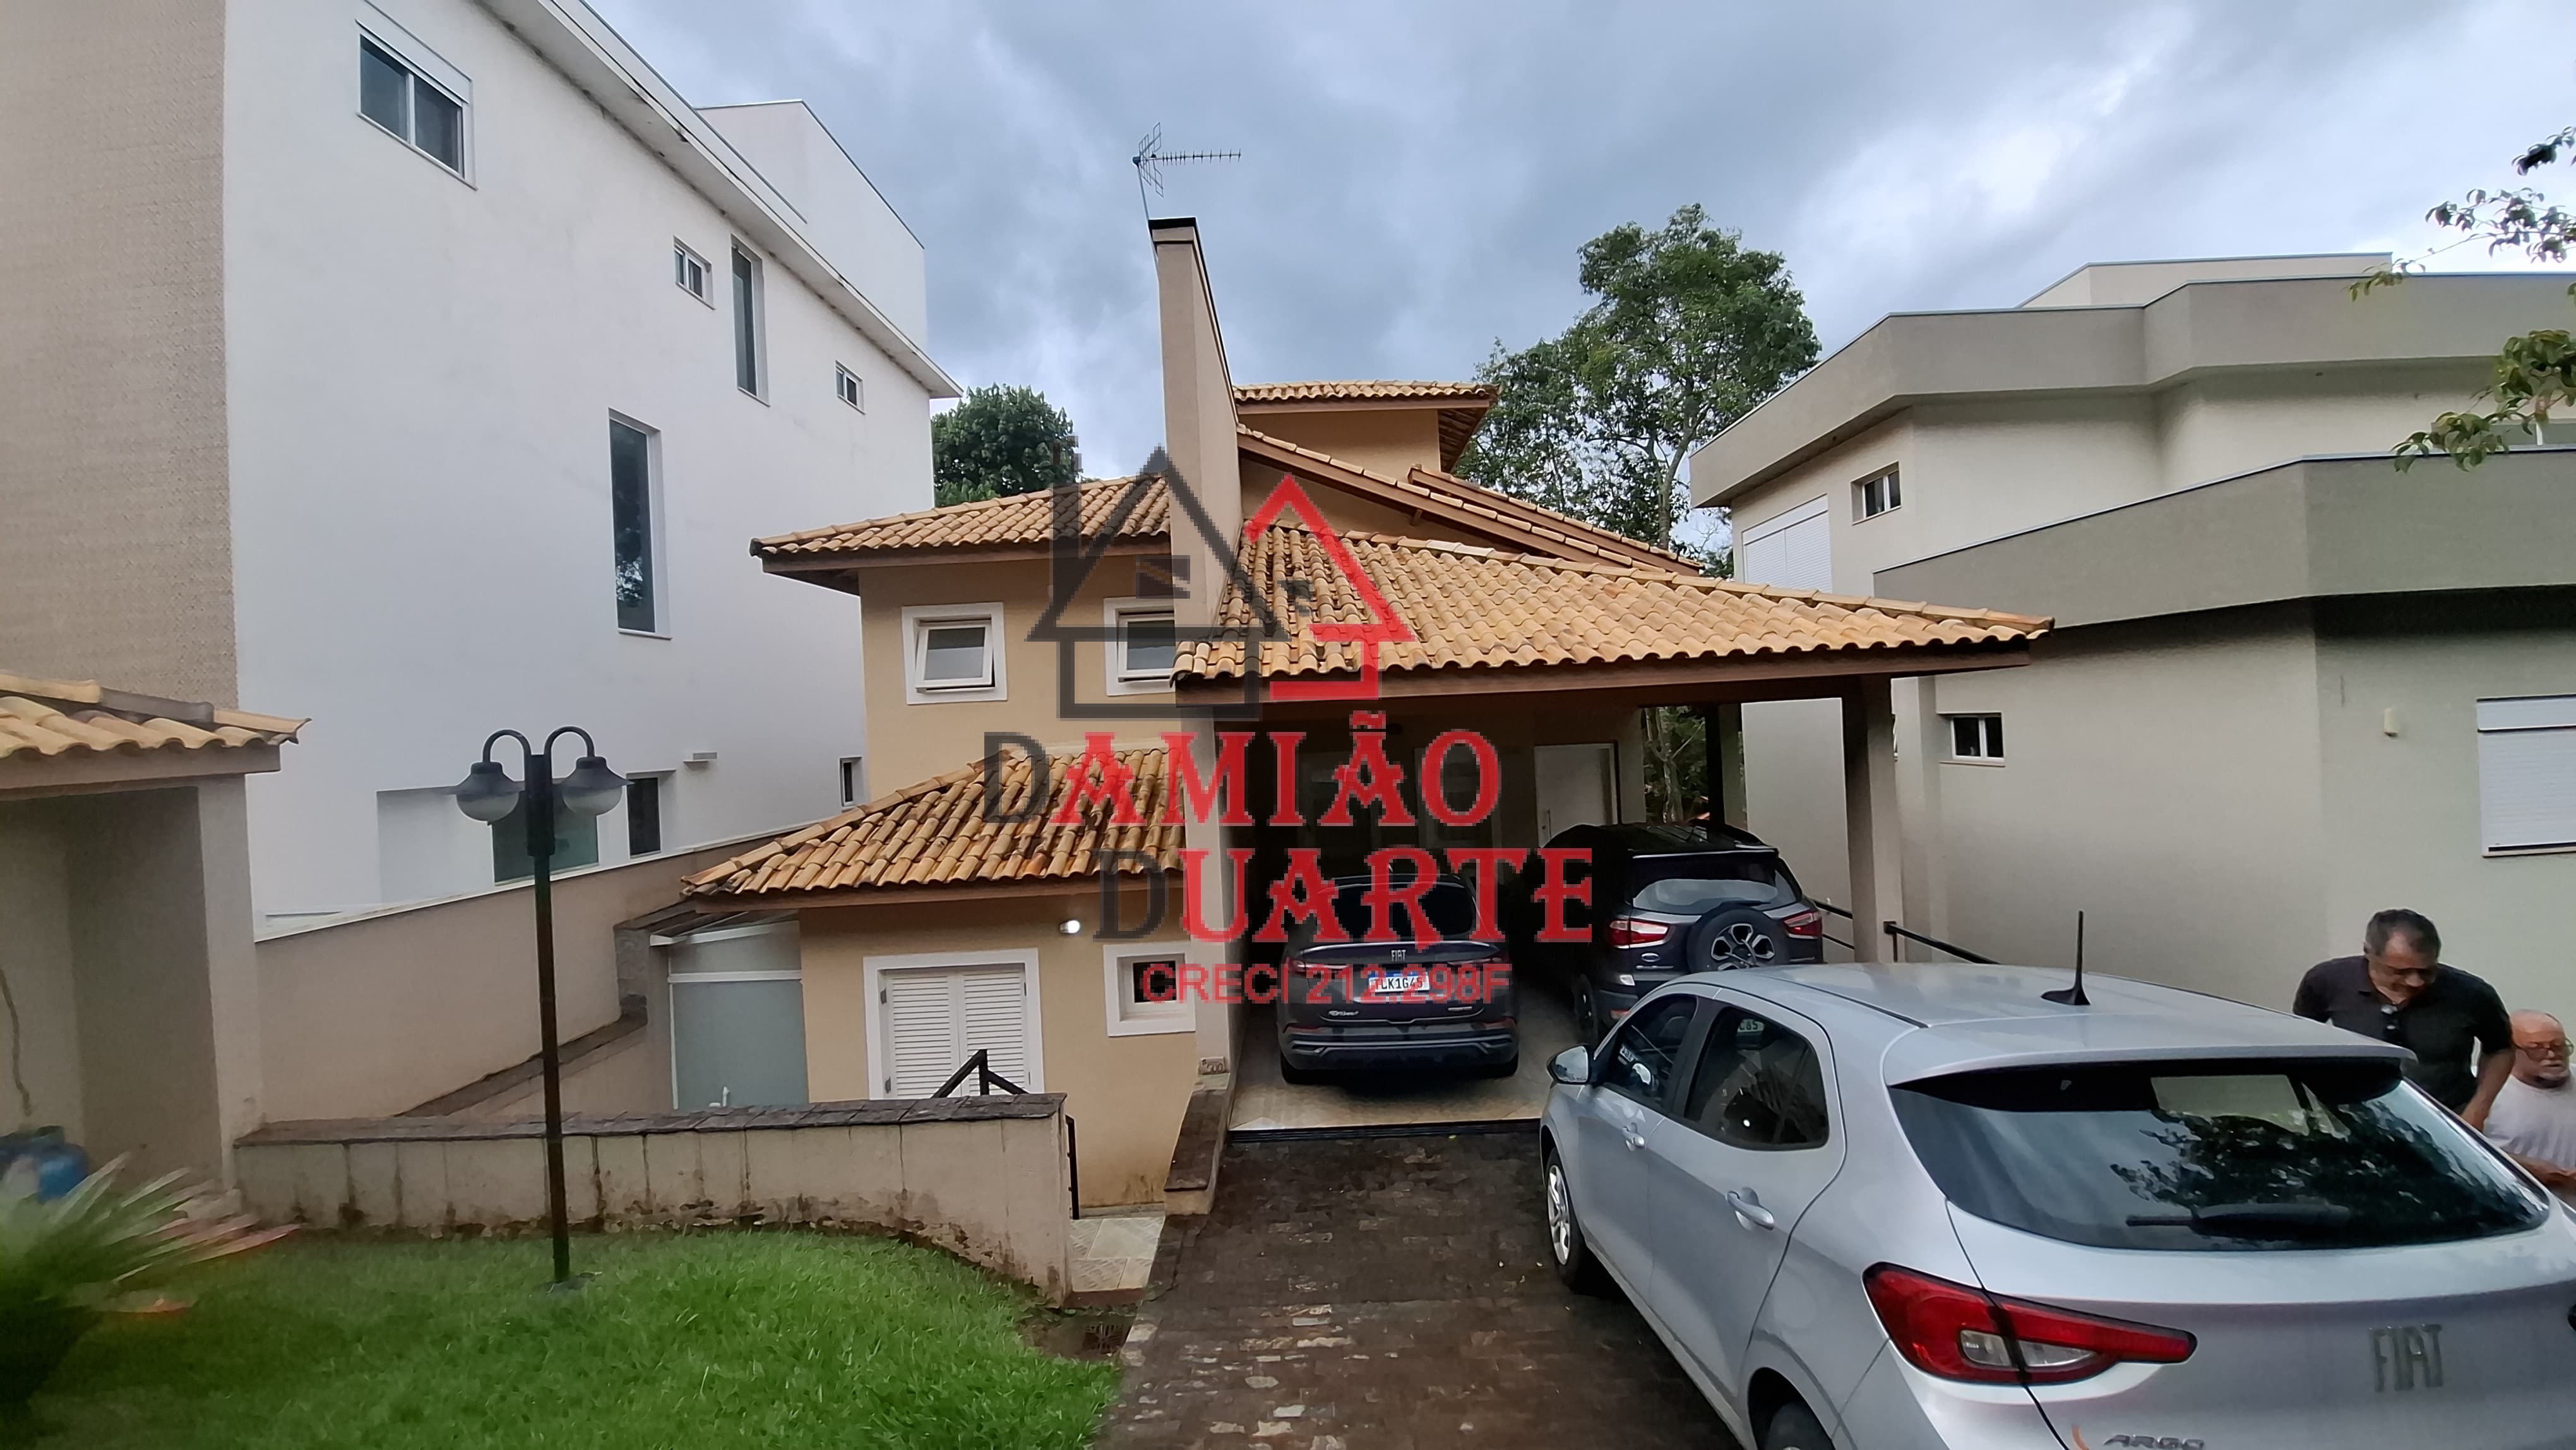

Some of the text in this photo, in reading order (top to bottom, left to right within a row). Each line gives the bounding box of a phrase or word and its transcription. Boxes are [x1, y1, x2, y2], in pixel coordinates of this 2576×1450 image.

[1391, 949, 1407, 962] FIAT
[2370, 1324, 2443, 1392] FIAT
[2104, 1434, 2205, 1450] ARGO
